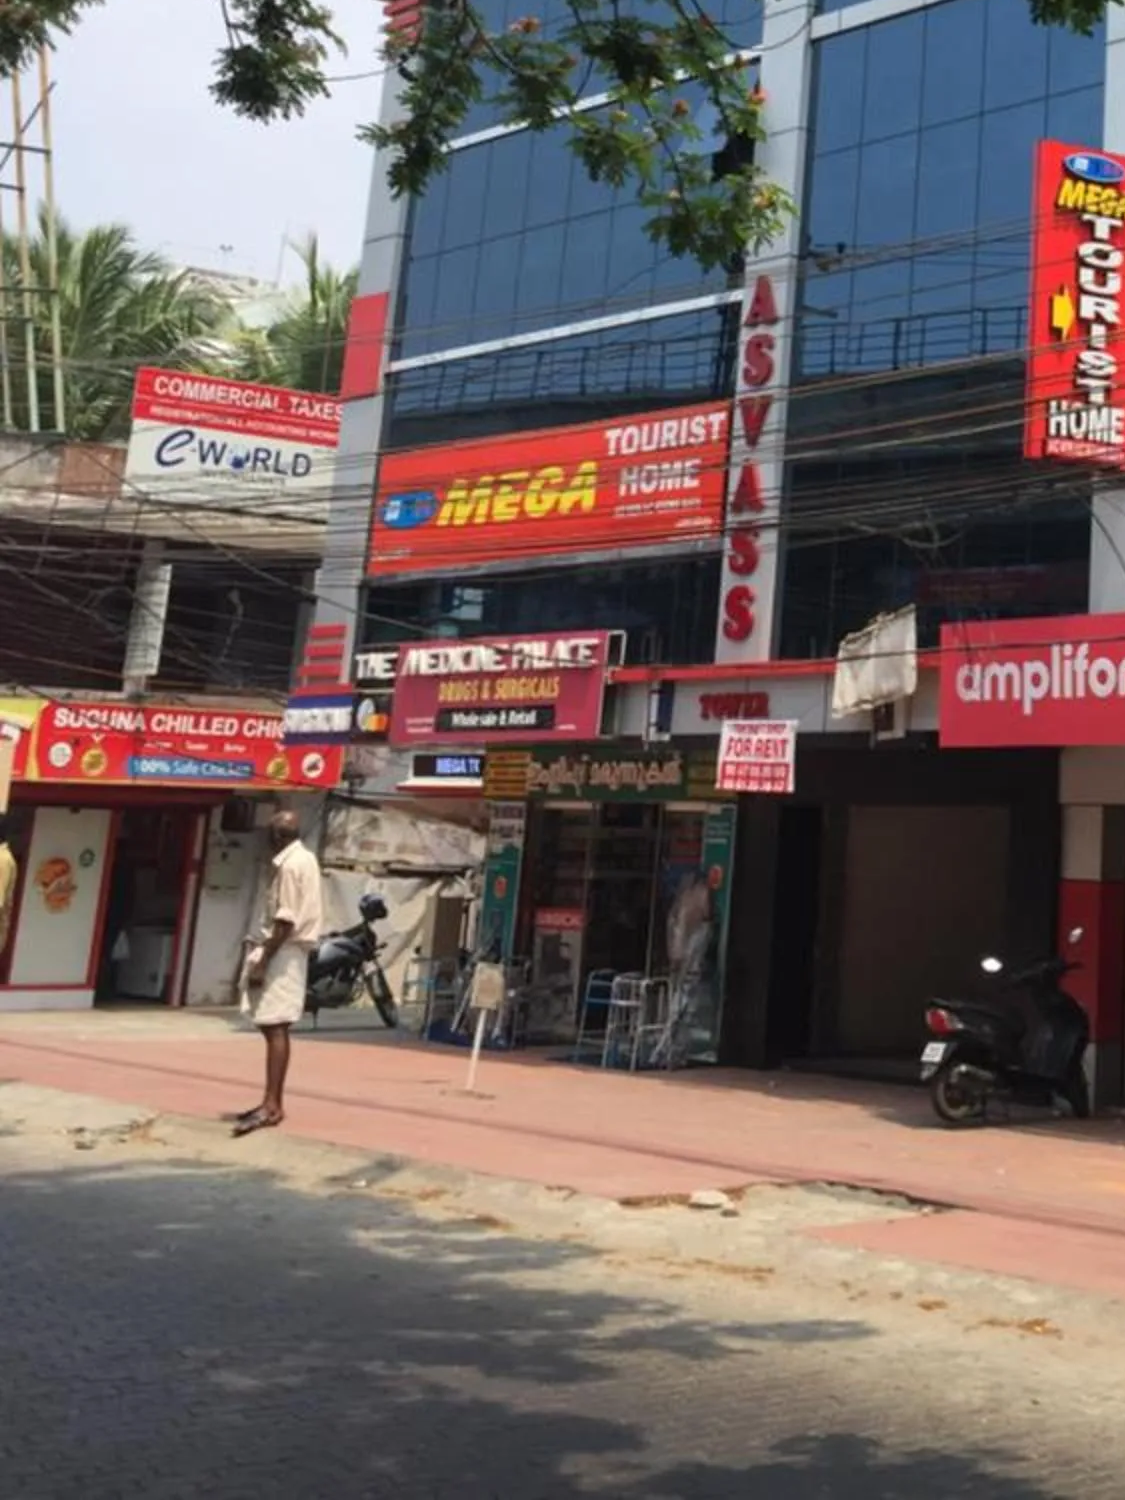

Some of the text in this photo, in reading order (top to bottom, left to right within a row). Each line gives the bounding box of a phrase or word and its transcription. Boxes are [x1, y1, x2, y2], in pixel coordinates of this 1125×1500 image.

[1077, 214, 1124, 404] TOURIST
[153, 375, 344, 422] COMMERCIAL TAXES
[1049, 399, 1125, 445] HOME
[604, 409, 728, 457] TOURIST
[618, 458, 702, 497] HOME
[721, 274, 779, 644] ASVASS
[436, 460, 599, 527] MEGA
[355, 651, 399, 679] THE
[53, 706, 146, 732] SUGUNA
[150, 711, 240, 737] CHILLED
